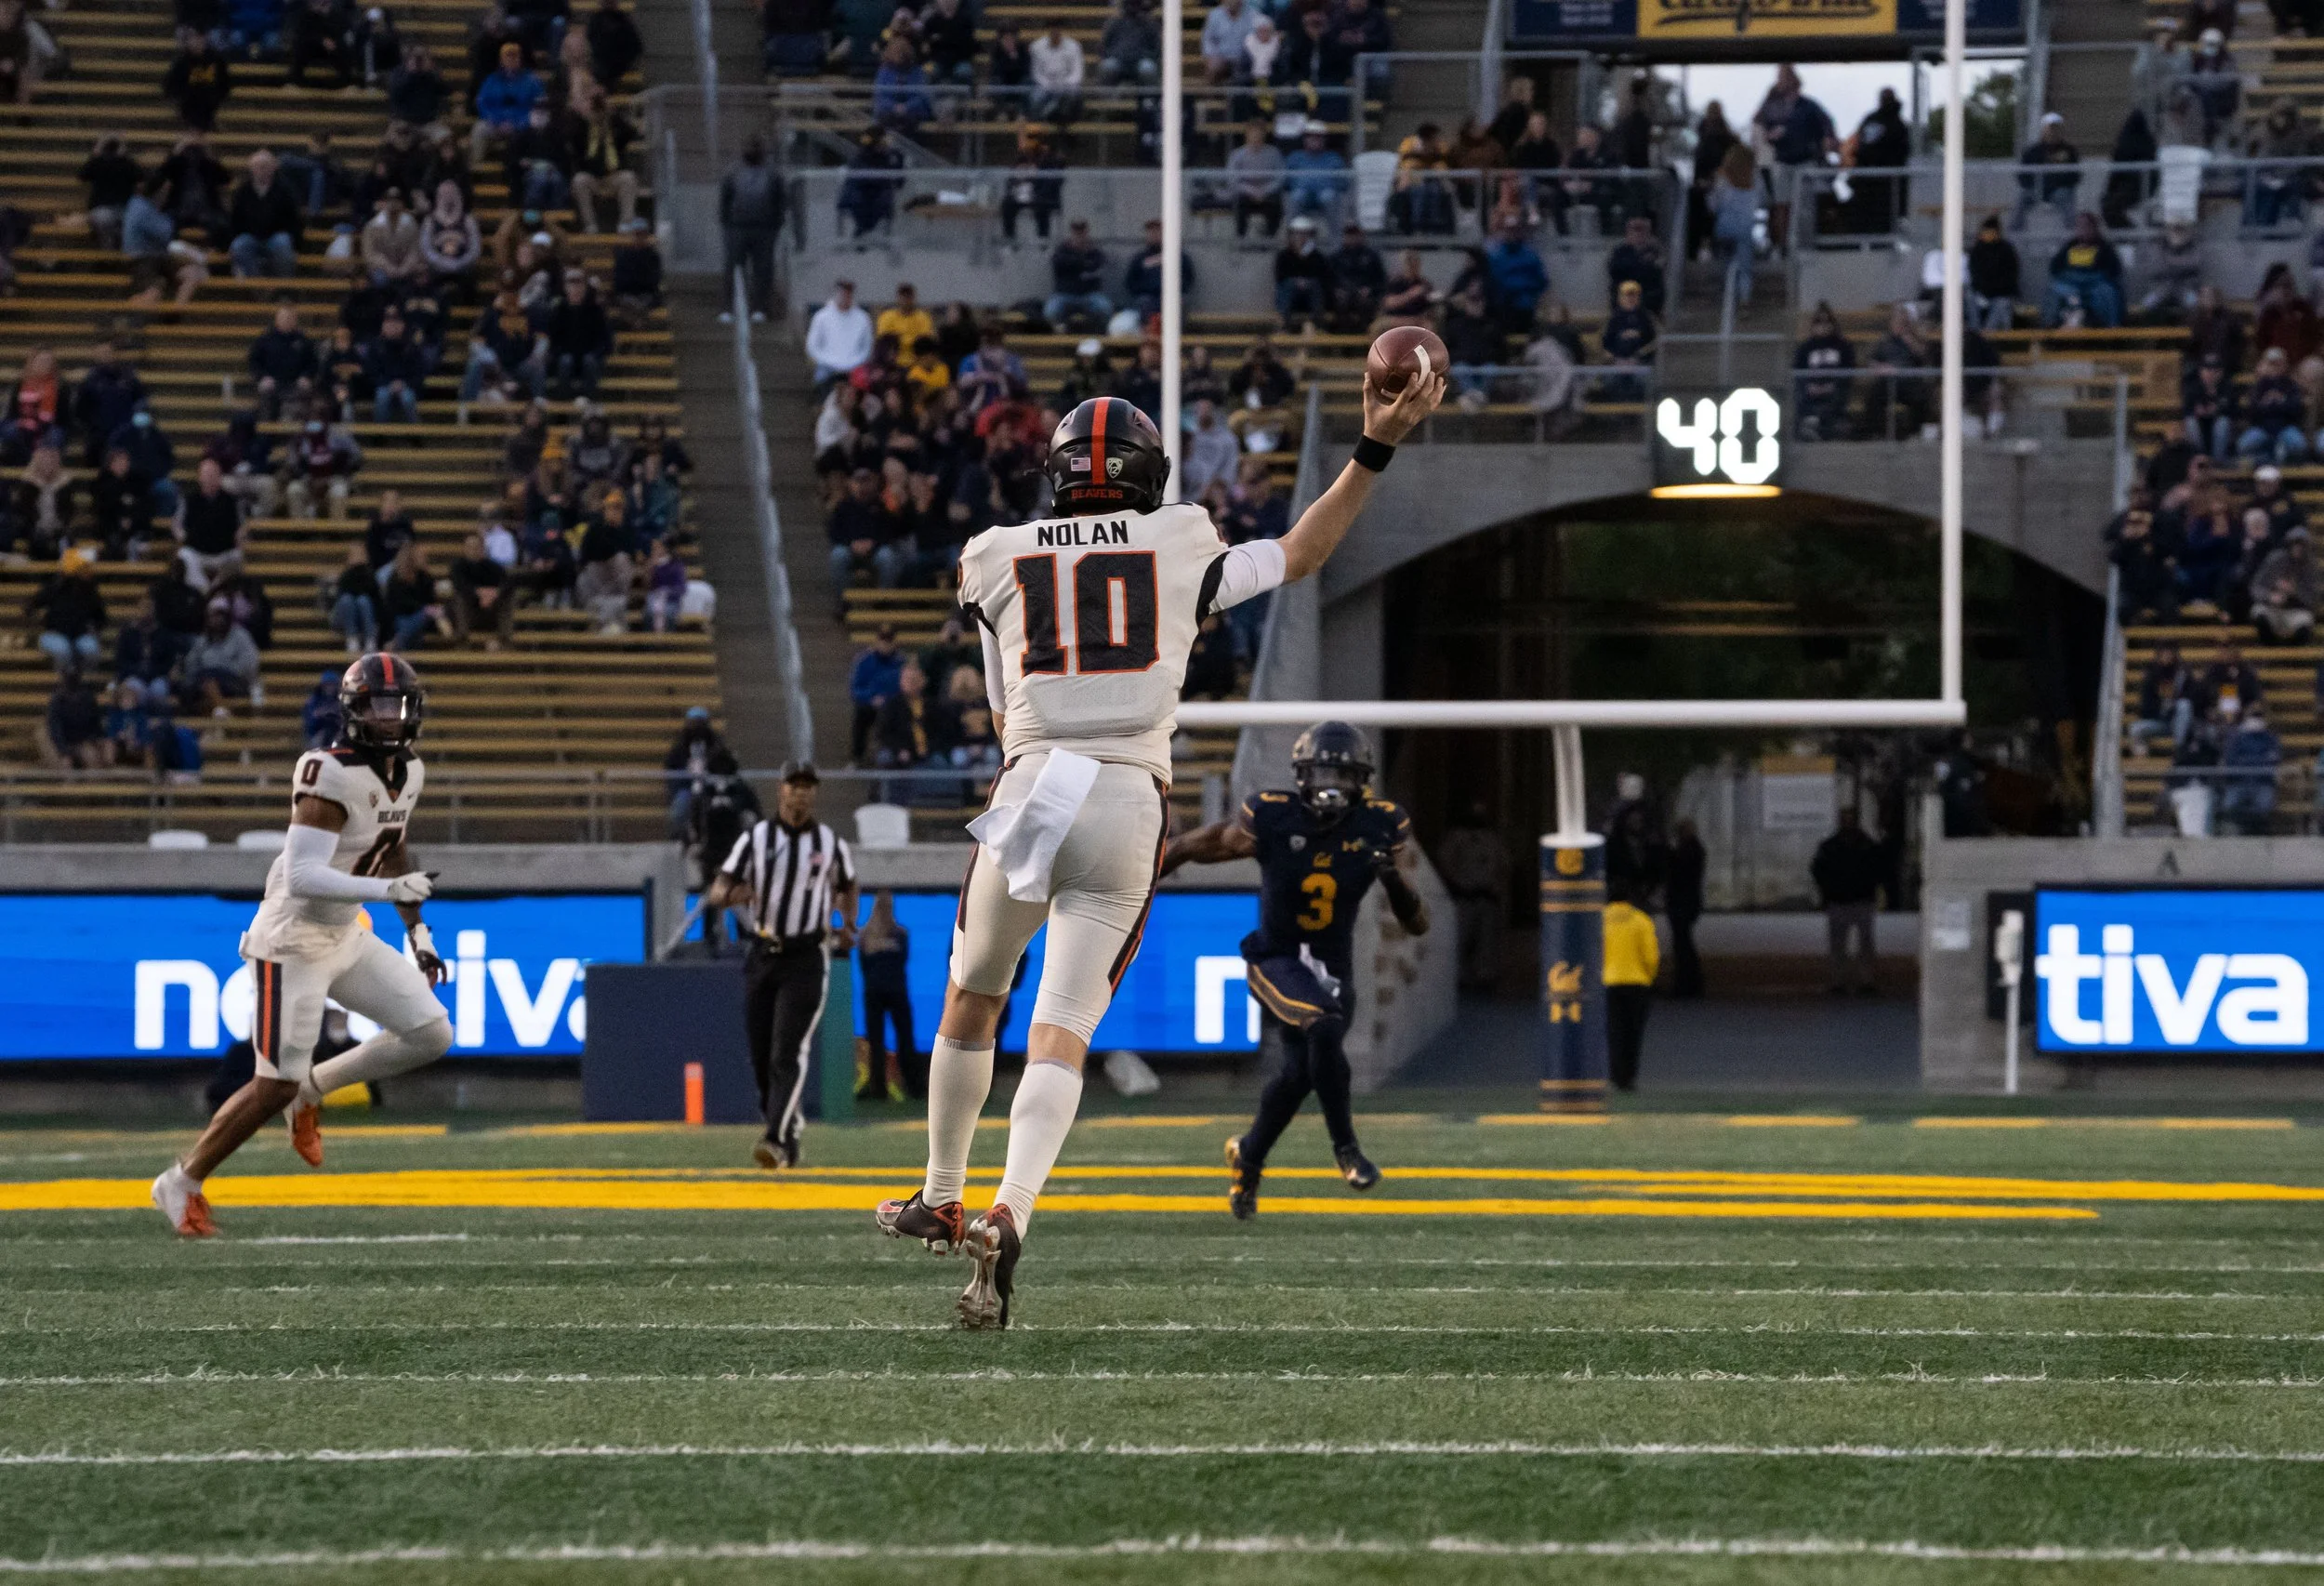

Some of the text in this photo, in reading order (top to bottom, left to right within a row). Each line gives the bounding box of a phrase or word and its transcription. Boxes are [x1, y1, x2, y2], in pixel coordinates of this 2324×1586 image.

[1657, 388, 1780, 484] 40
[1071, 488, 1123, 499] BEAVERS
[1037, 520, 1129, 547] NOLAN
[1012, 550, 1160, 679] 10
[301, 759, 324, 786] 0
[1297, 872, 1337, 931] 3
[2035, 923, 2308, 1045] tiva
